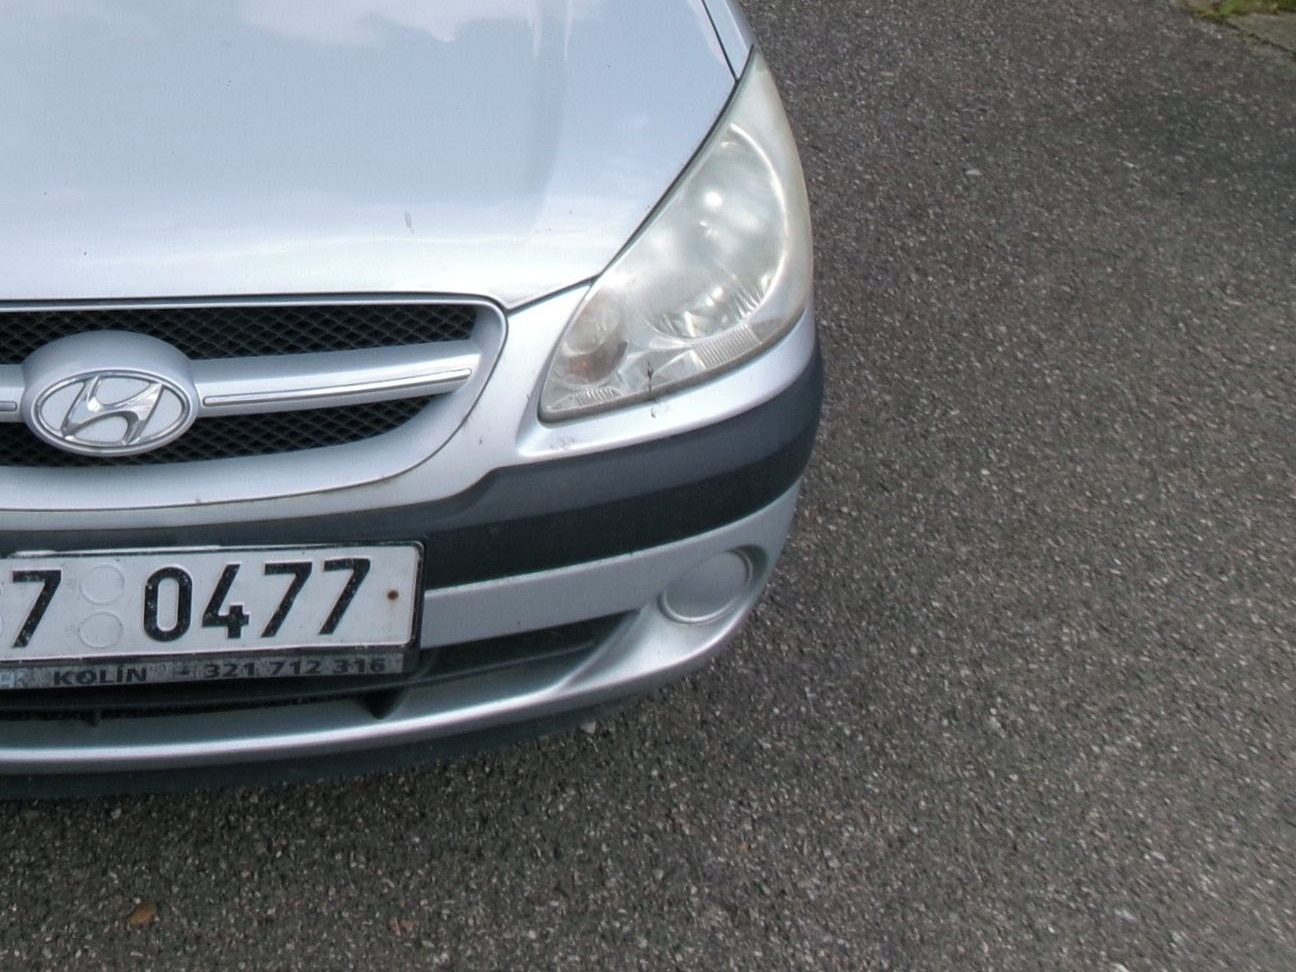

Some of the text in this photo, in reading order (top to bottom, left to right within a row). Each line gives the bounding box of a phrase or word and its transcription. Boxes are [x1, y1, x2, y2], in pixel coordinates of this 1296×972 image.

[143, 558, 372, 642] 0477
[203, 661, 256, 679] 321
[269, 659, 322, 676] 712
[335, 657, 387, 675] 316
